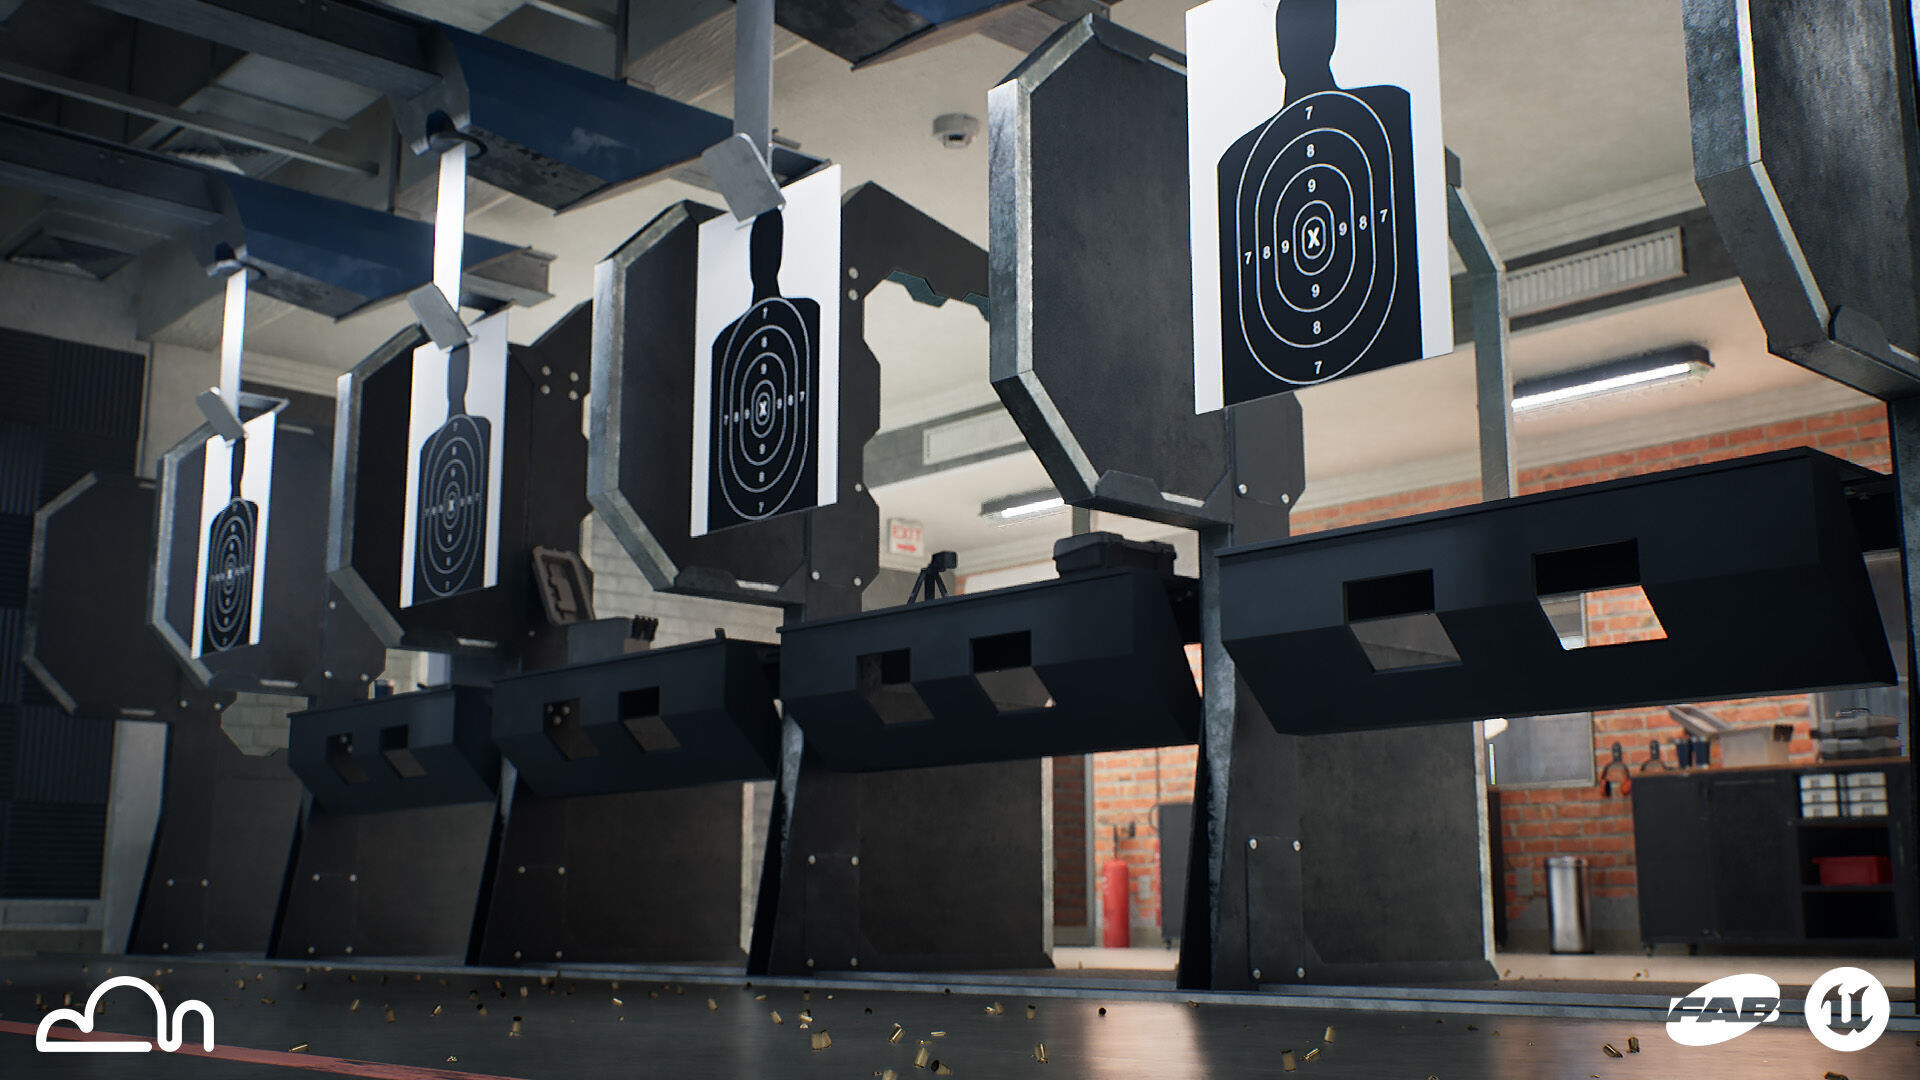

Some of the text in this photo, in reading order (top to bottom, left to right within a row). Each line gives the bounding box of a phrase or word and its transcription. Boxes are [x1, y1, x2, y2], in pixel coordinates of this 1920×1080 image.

[1304, 105, 1314, 121] 7
[1306, 143, 1316, 158] 8
[1307, 178, 1317, 193] 9
[1244, 208, 1388, 265] 7 8 9 X 9 8 7
[1311, 283, 1321, 298] 9
[1312, 320, 1322, 335] 8
[1314, 360, 1323, 375] 7
[758, 400, 768, 418] X
[758, 501, 765, 514] 7
[891, 524, 922, 542] EXIT
